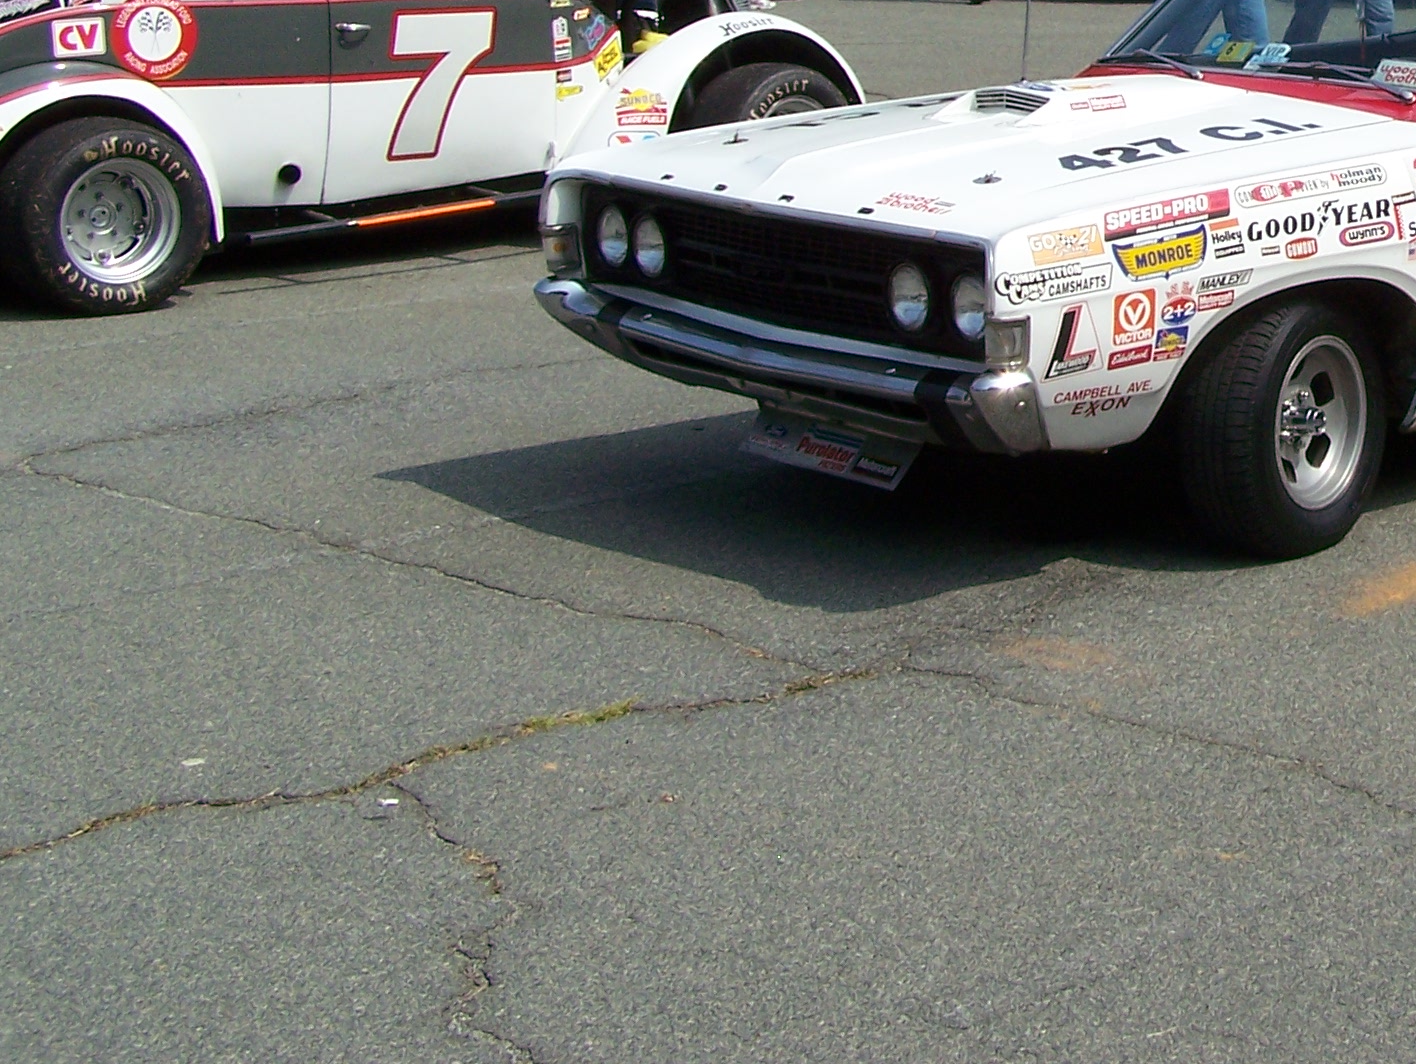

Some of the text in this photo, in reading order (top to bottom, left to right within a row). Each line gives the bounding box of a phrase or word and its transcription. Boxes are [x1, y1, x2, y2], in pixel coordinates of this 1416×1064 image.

[58, 23, 99, 51] CV
[1265, 46, 1287, 56] VIP
[123, 50, 189, 75] RACING ASSOCIATION
[386, 6, 498, 162] 7
[620, 91, 663, 107] SUNOCO
[1058, 117, 1323, 171] 427 C.I.
[101, 136, 193, 182] Hoosier
[1330, 166, 1382, 184] holman
[1338, 173, 1384, 188] moody
[1105, 194, 1209, 231] SPEED-PRO
[1029, 237, 1056, 252] GO
[1211, 230, 1243, 244] Holley
[1134, 242, 1194, 269] MONROE
[995, 262, 1084, 295] COMPETITION
[1049, 274, 1107, 296] CAMSHAFTS
[1200, 273, 1242, 290] MANLEY
[1163, 302, 1195, 320] 2+2
[1114, 329, 1153, 345] VICTOR
[1053, 380, 1153, 404] CAMPBELL AVE.
